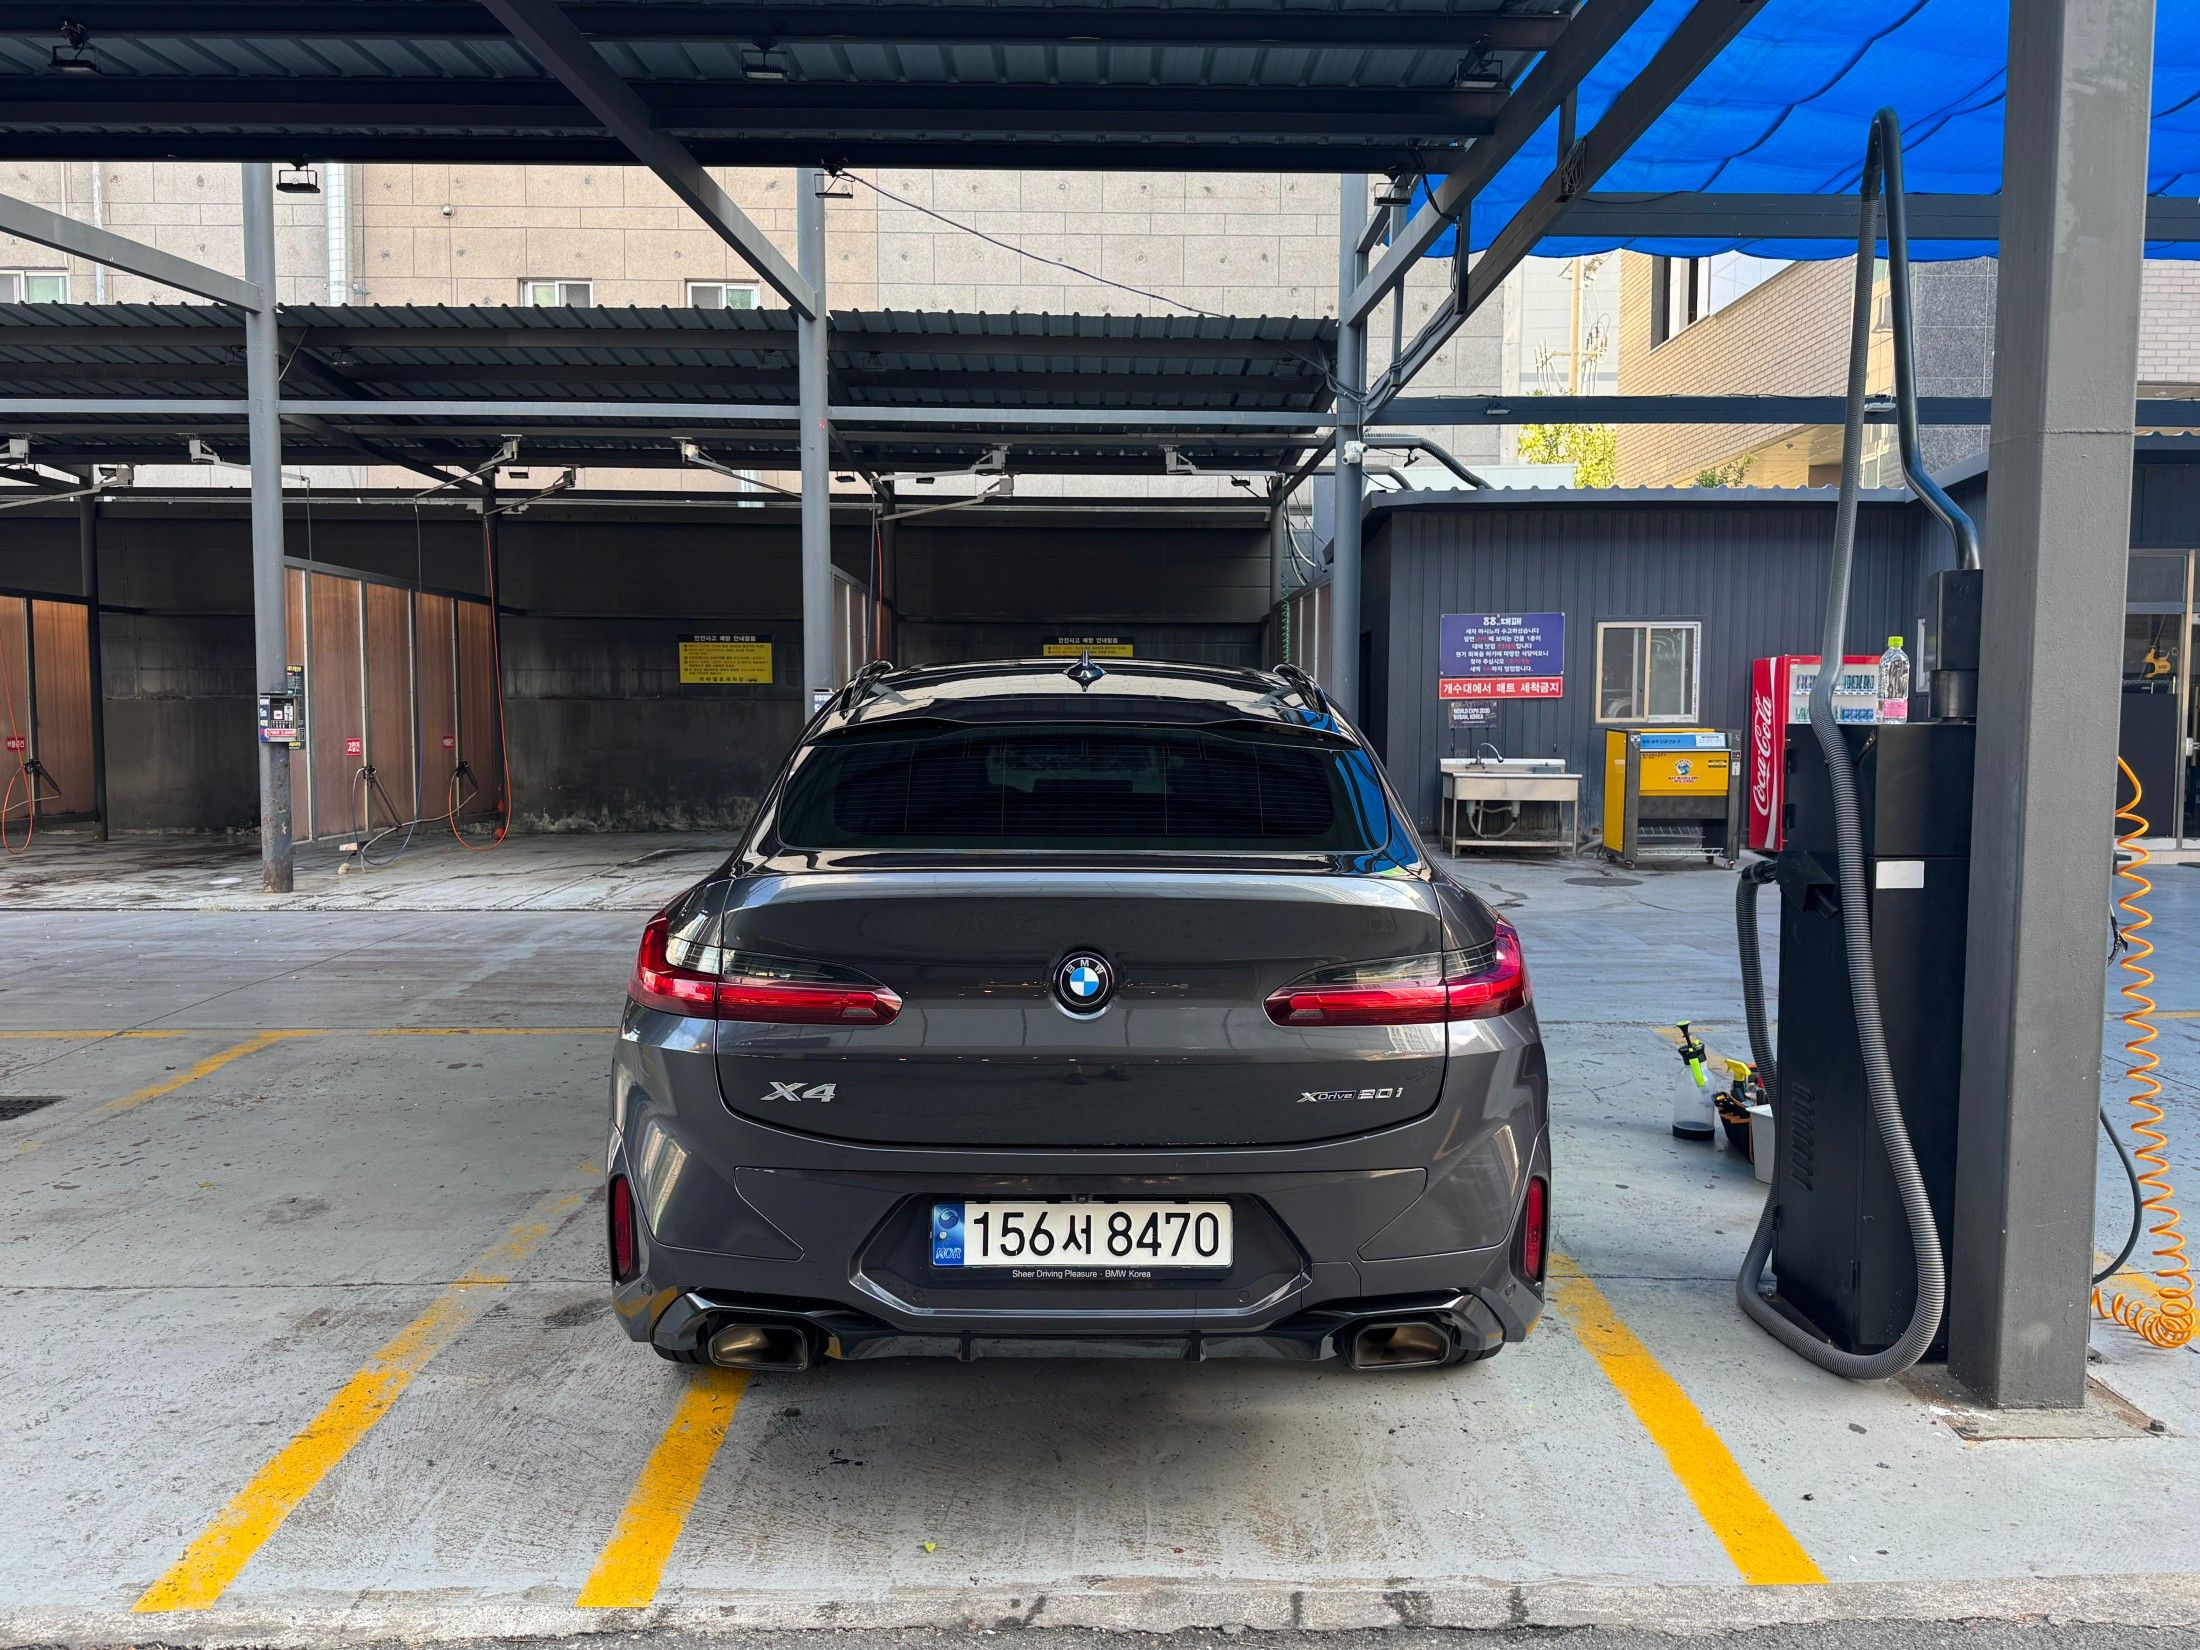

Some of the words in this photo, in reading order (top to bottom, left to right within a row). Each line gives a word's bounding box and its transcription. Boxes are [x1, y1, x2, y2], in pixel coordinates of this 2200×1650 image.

[1443, 682, 1492, 694] 개수대에서
[1496, 682, 1516, 693] 매트
[1521, 682, 1559, 693] 세척금지
[1066, 960, 1104, 974] BMW
[759, 1081, 837, 1102] X4
[1357, 1087, 1404, 1100] 20i
[973, 1211, 1091, 1257] 156서
[1107, 1211, 1219, 1257] 8470
[935, 1247, 961, 1259] KOR
[1012, 1269, 1035, 1279] Sheer
[1036, 1269, 1063, 1280] Driving
[1064, 1269, 1098, 1279] Pleasure
[1104, 1269, 1127, 1279] BMW
[1128, 1269, 1151, 1279] Korea
